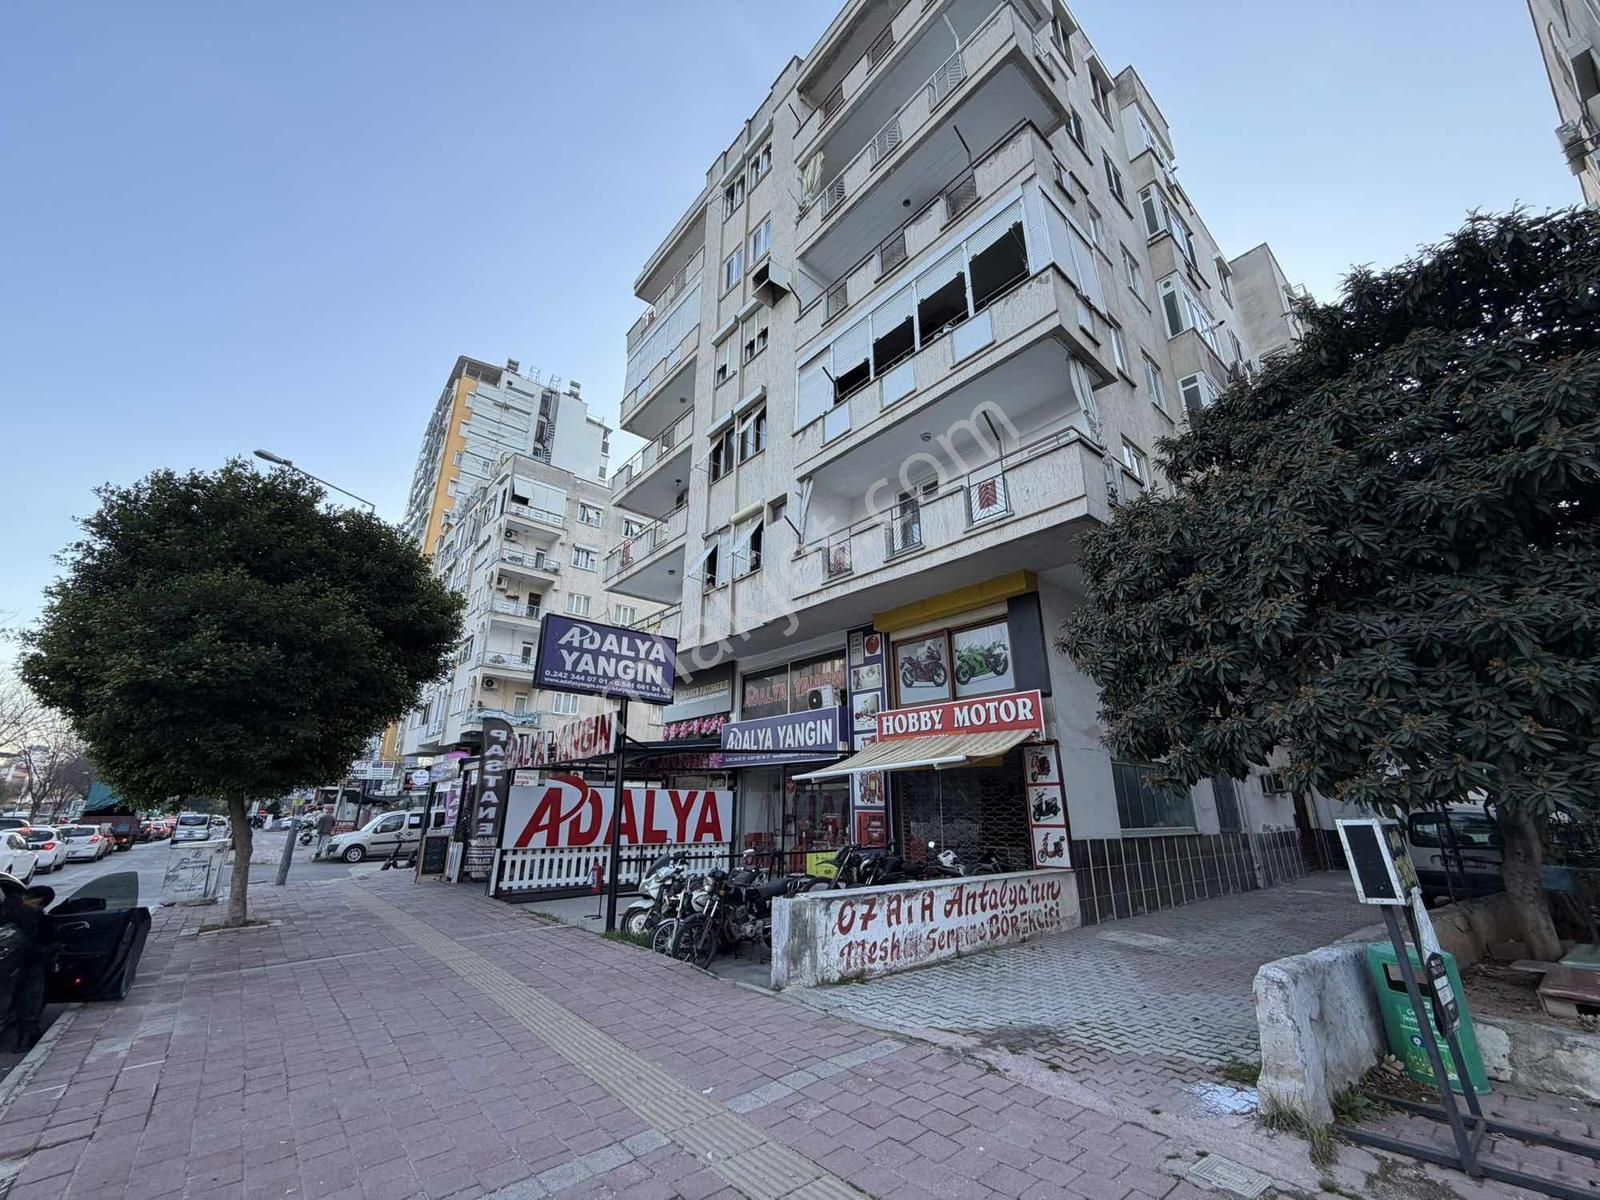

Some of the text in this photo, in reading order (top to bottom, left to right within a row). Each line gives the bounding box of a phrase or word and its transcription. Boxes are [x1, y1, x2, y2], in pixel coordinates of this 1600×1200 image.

[558, 624, 666, 662] ADALYA
[545, 670, 569, 679] 0.242
[588, 675, 597, 683] 07
[560, 649, 663, 684] YANGIN
[745, 683, 787, 707] ADALYA
[726, 719, 832, 750] ADALYA YANGIN
[882, 698, 1034, 735] HOBBY MOTOR
[513, 775, 722, 848] ADALYA
[834, 898, 877, 937] 07
